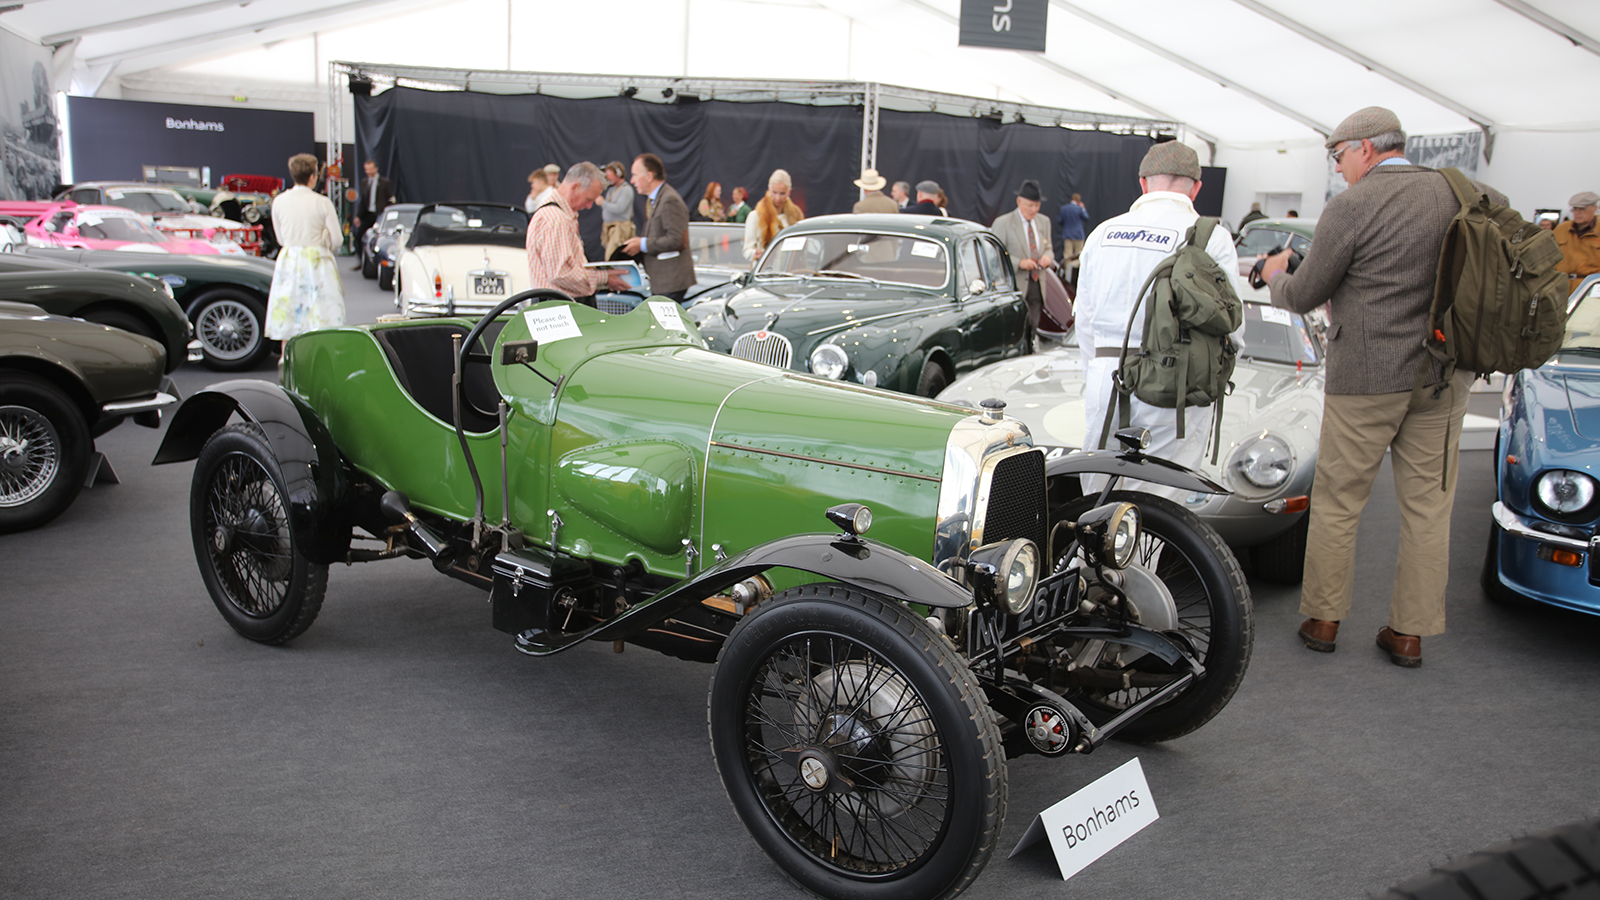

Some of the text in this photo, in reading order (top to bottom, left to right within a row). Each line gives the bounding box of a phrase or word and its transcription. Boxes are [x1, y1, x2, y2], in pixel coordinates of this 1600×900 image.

[165, 117, 225, 131] Bonhams
[1106, 229, 1171, 245] GOODYEAR
[532, 316, 557, 325] Please
[549, 321, 570, 329] touch
[1018, 573, 1078, 632] 2677
[1062, 790, 1140, 849] Bonhams
